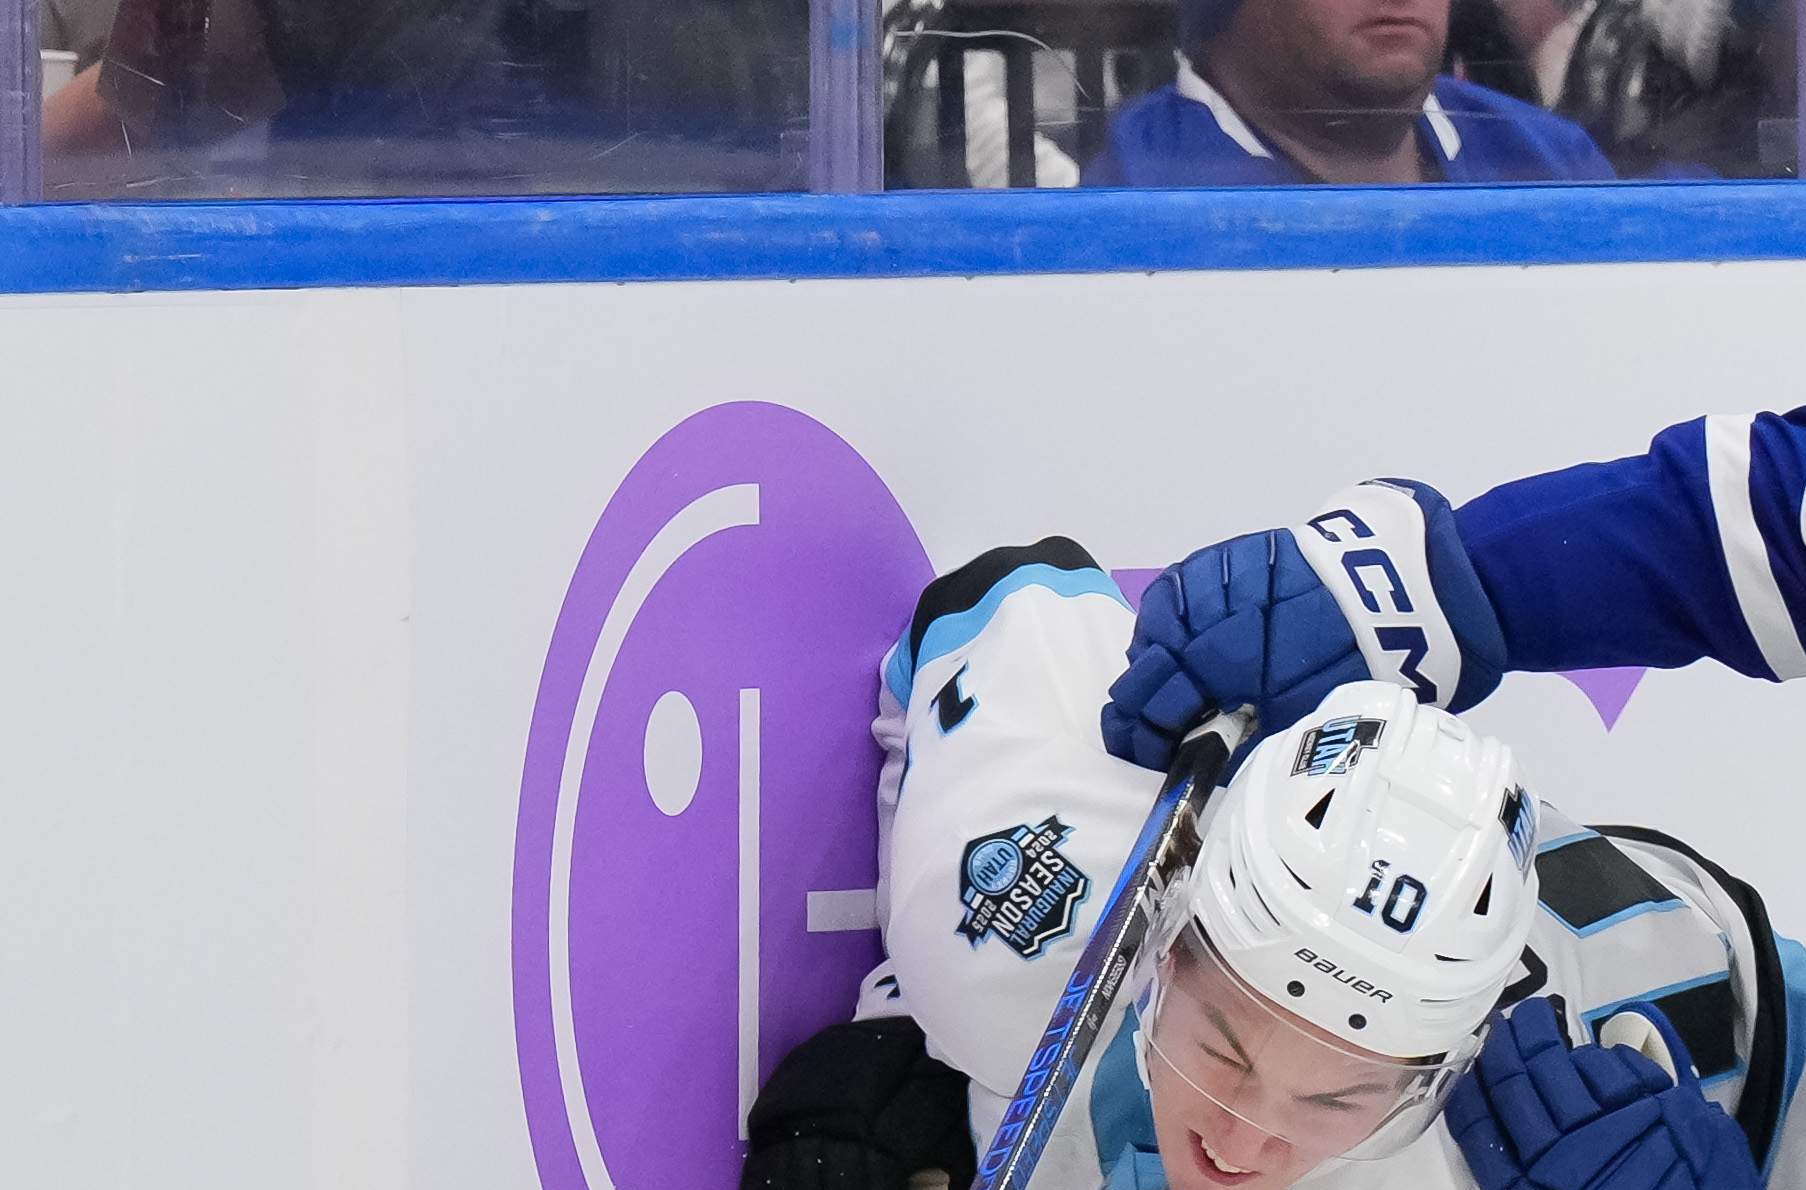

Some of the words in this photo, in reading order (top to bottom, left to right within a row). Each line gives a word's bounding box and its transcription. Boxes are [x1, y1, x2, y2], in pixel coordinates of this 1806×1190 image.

[1307, 509, 1438, 704] CCM
[976, 847, 1014, 887] UTAH
[1025, 829, 1058, 858] 2024
[971, 898, 998, 933] 2025
[991, 851, 1065, 938] SEASON
[1009, 866, 1079, 946] INAUGURAL
[1352, 859, 1428, 934] 10
[979, 970, 1094, 1177] JETSPEED
